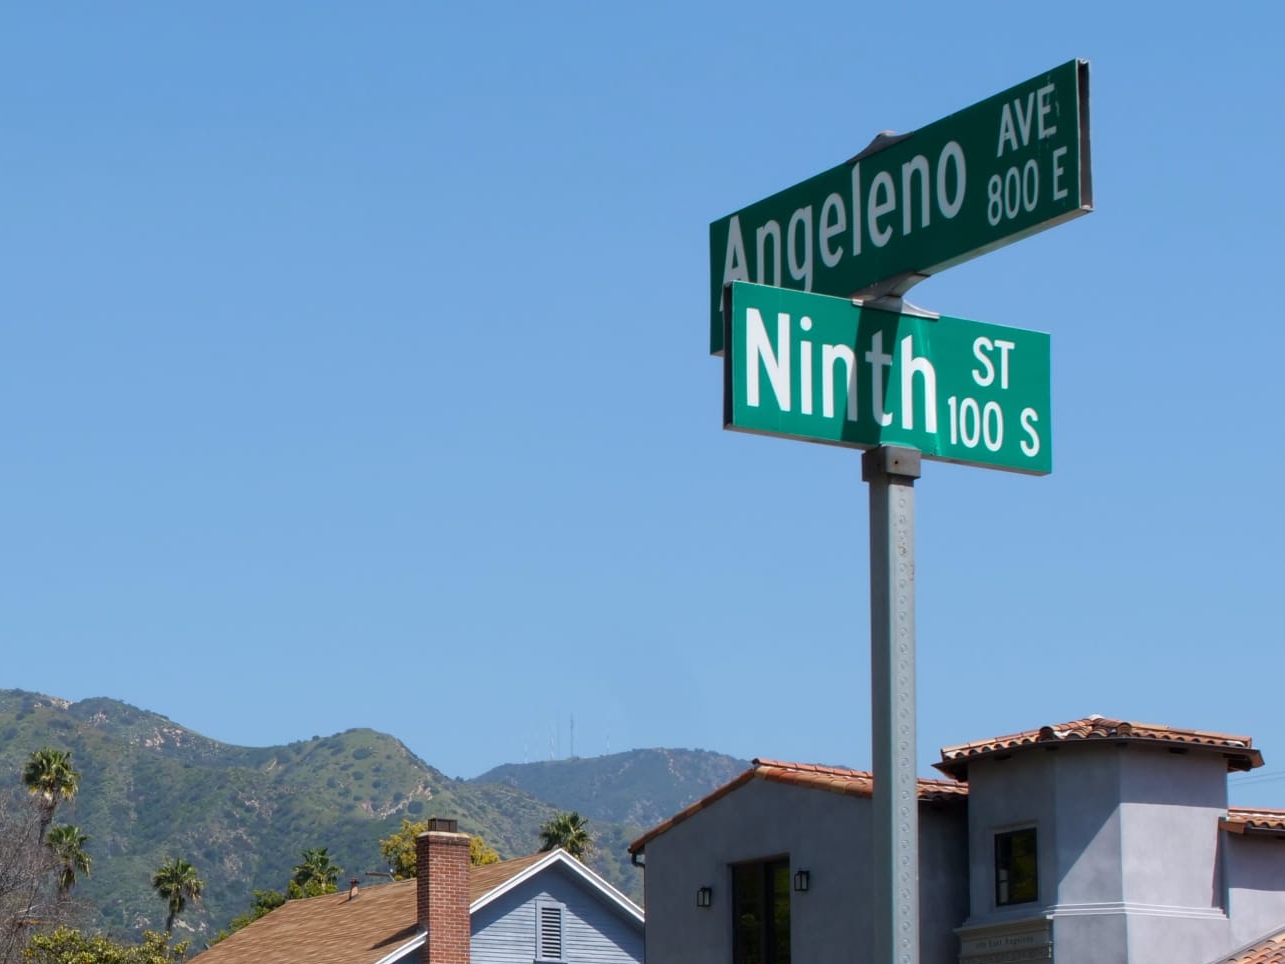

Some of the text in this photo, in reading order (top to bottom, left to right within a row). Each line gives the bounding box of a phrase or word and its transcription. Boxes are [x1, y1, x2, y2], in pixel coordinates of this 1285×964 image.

[719, 83, 1057, 311] Angeleno AVE
[987, 146, 1068, 227] 800 E
[746, 307, 1014, 434] Ninth ST
[947, 395, 1040, 458] 100 S
